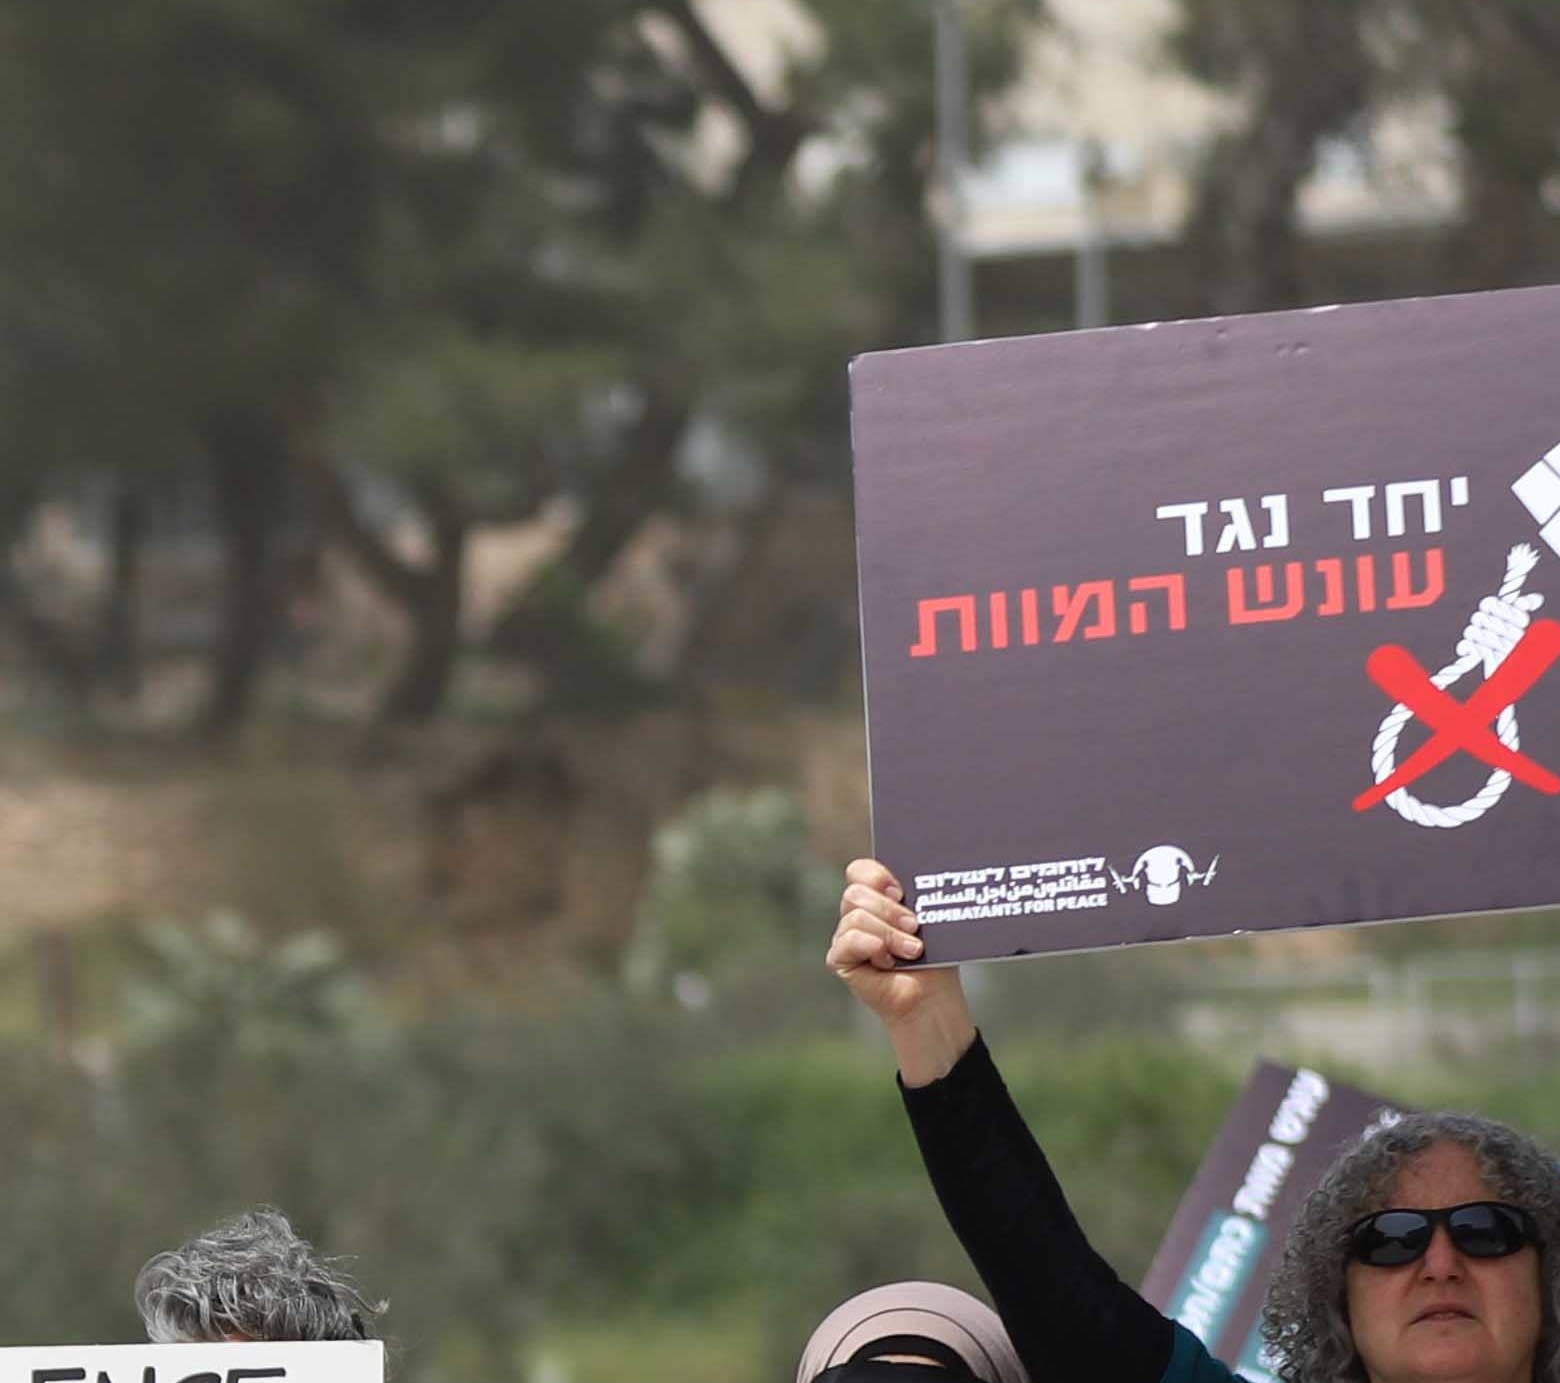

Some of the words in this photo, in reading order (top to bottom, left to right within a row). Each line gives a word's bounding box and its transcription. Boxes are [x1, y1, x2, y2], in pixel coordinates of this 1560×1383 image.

[1156, 495, 1289, 557] נגד
[1323, 477, 1470, 540] יחד
[909, 573, 1186, 657] המוות
[1228, 548, 1446, 627] עונש
[915, 867, 1005, 889] לשלום
[1010, 857, 1105, 880] לוחמים
[917, 902, 1022, 924] COMBATANTS
[1024, 898, 1055, 914] FOR
[1057, 893, 1107, 910] PEACE
